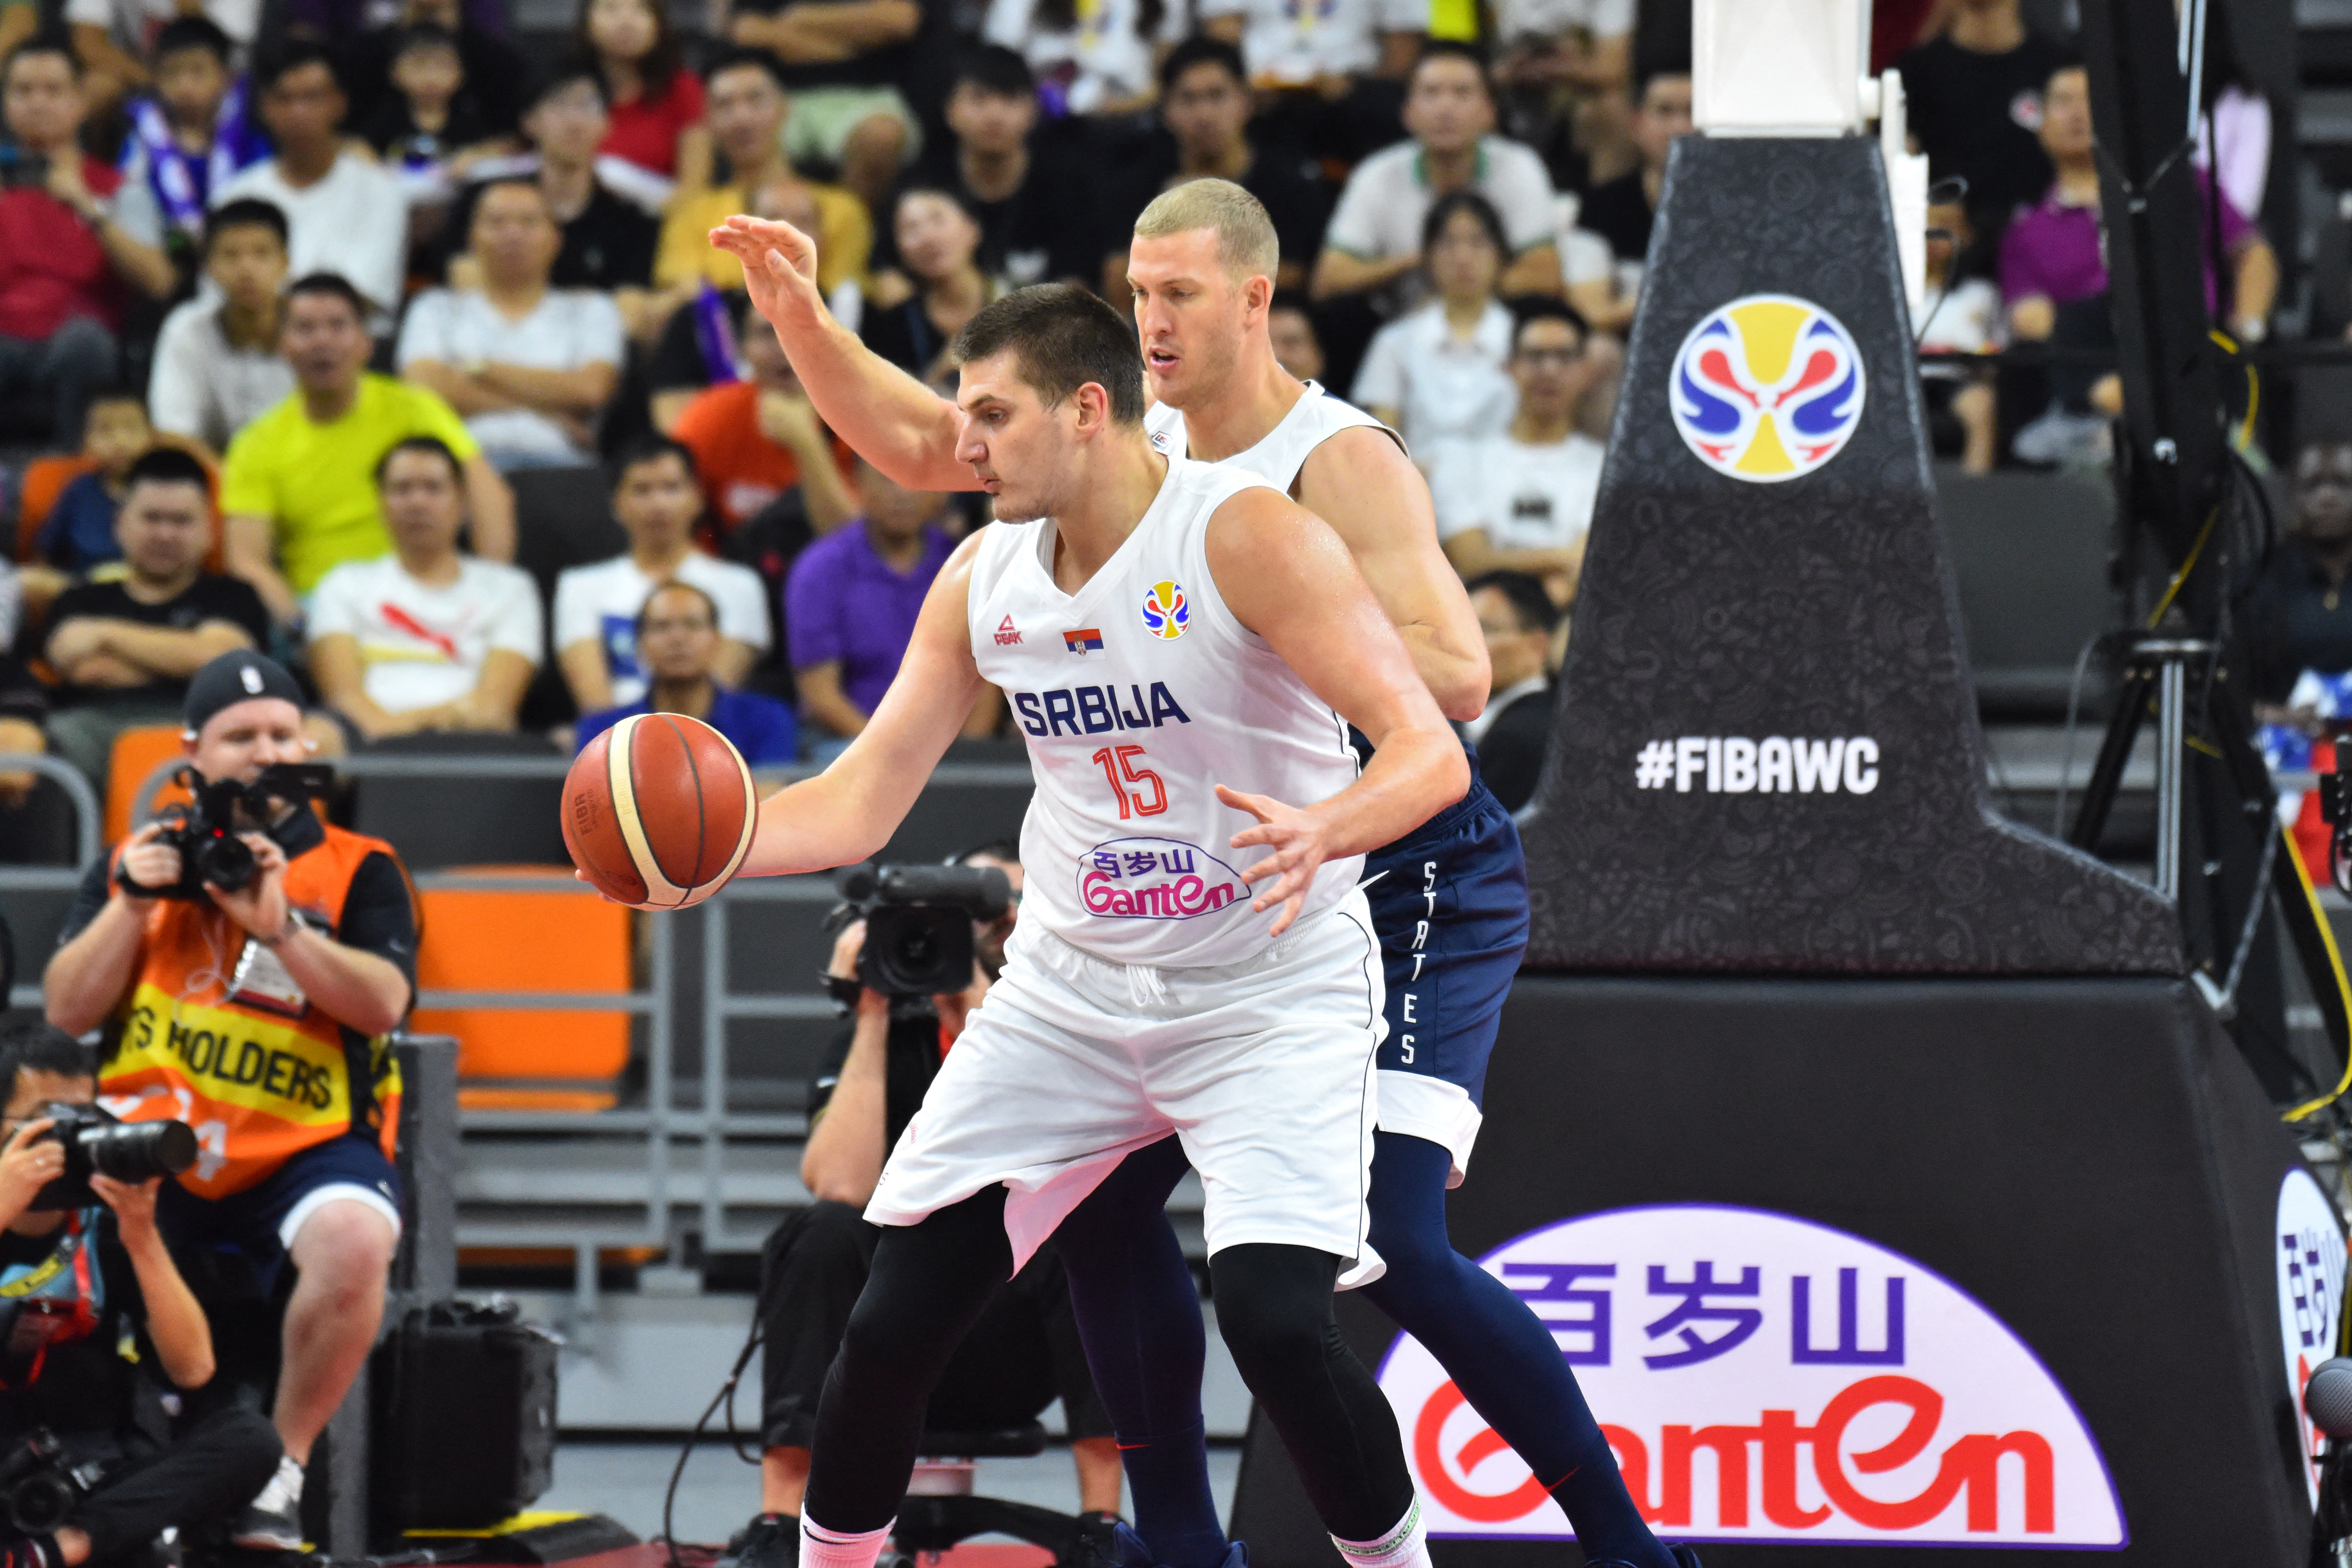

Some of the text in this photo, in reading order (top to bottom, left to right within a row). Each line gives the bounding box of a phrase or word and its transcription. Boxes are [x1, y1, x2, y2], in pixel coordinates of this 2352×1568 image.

[993, 631, 1024, 646] PEAK
[1014, 681, 1191, 737] SRBIJA
[1093, 745, 1168, 819] 15
[1635, 737, 1879, 794] #FIBAWC
[574, 793, 591, 836] FIBA
[1094, 849, 1195, 878] 百岁山
[1401, 862, 1436, 1064] STATES
[166, 1021, 332, 1110] HOLDERS
[1502, 1261, 1906, 1370] 百岁山
